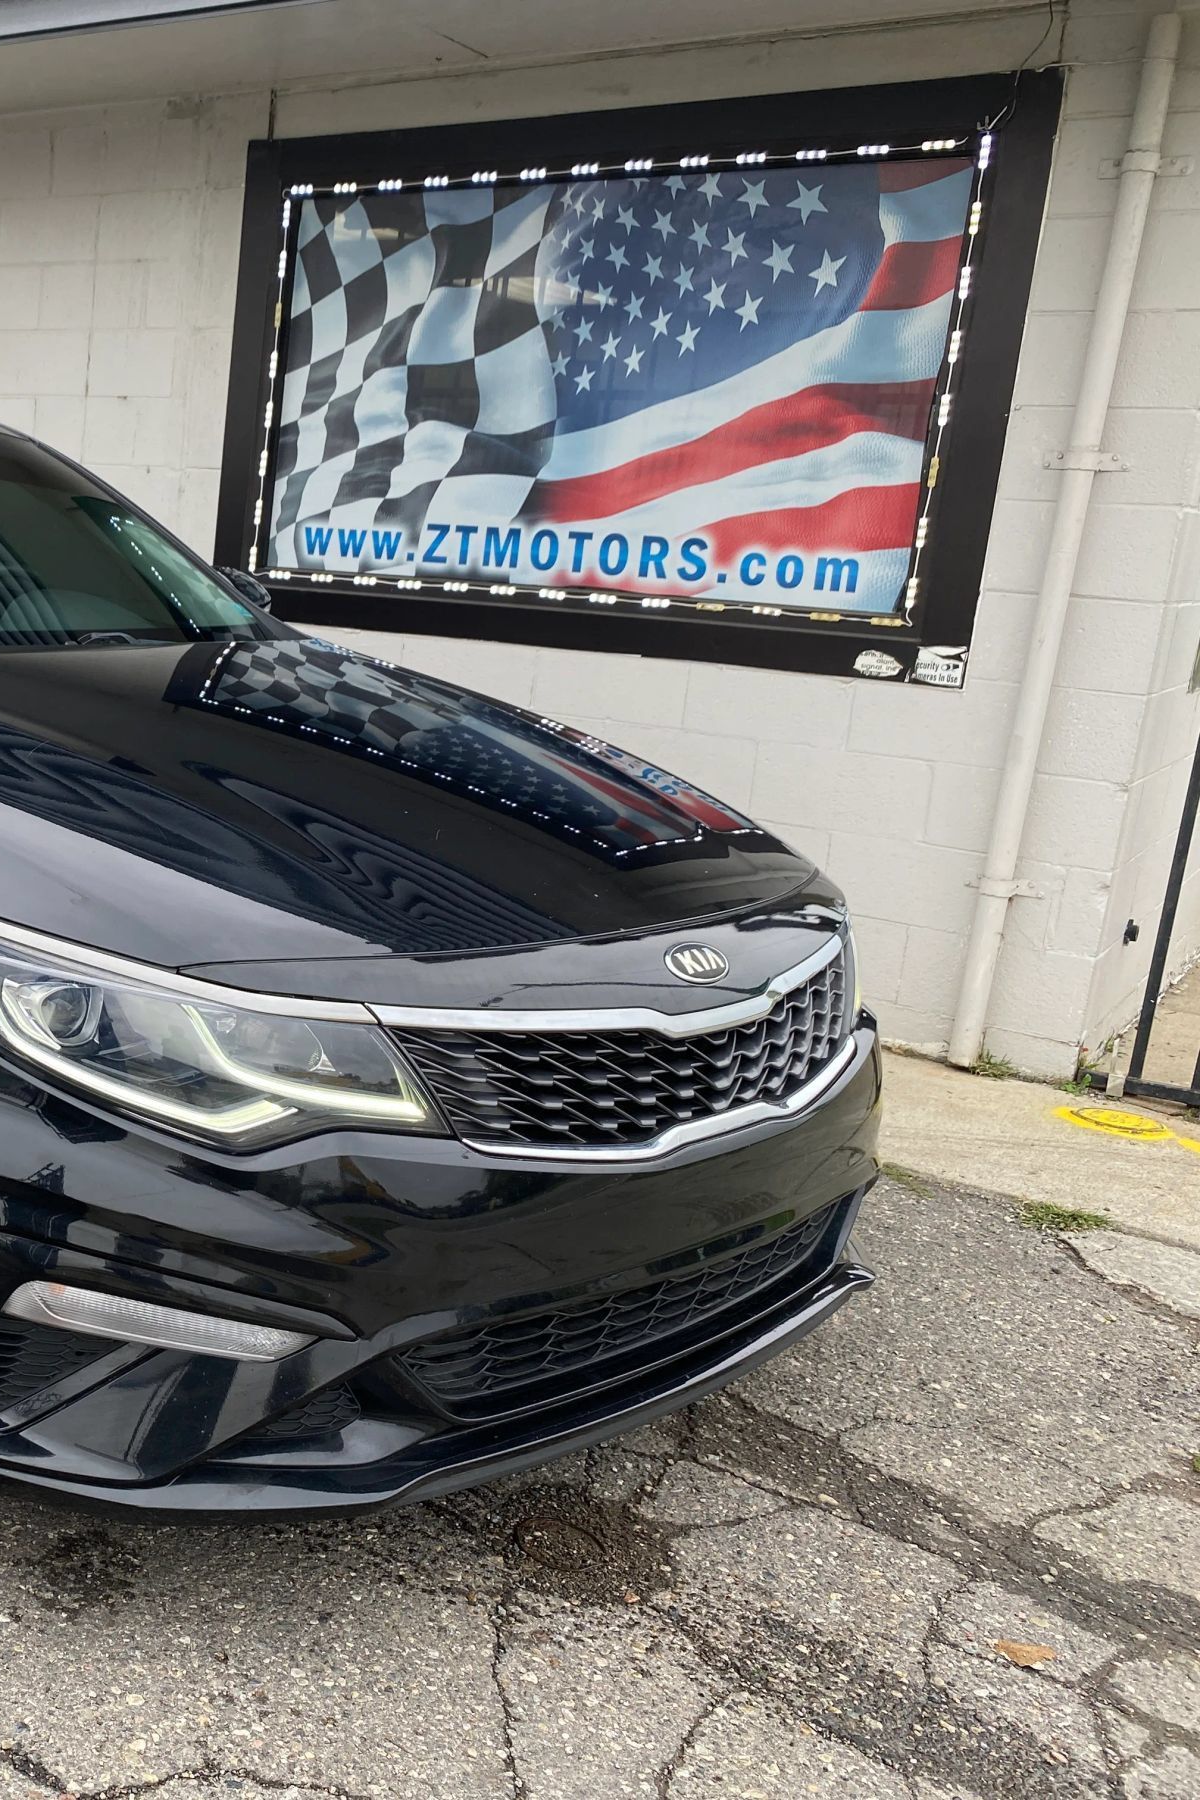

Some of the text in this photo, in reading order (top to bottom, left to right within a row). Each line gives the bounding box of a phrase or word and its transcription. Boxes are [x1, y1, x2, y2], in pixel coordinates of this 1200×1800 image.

[304, 523, 860, 593] www.ZTMOTORS.com
[916, 661, 940, 672] ecurity
[917, 673, 937, 682] meras
[673, 947, 726, 975] KIA
